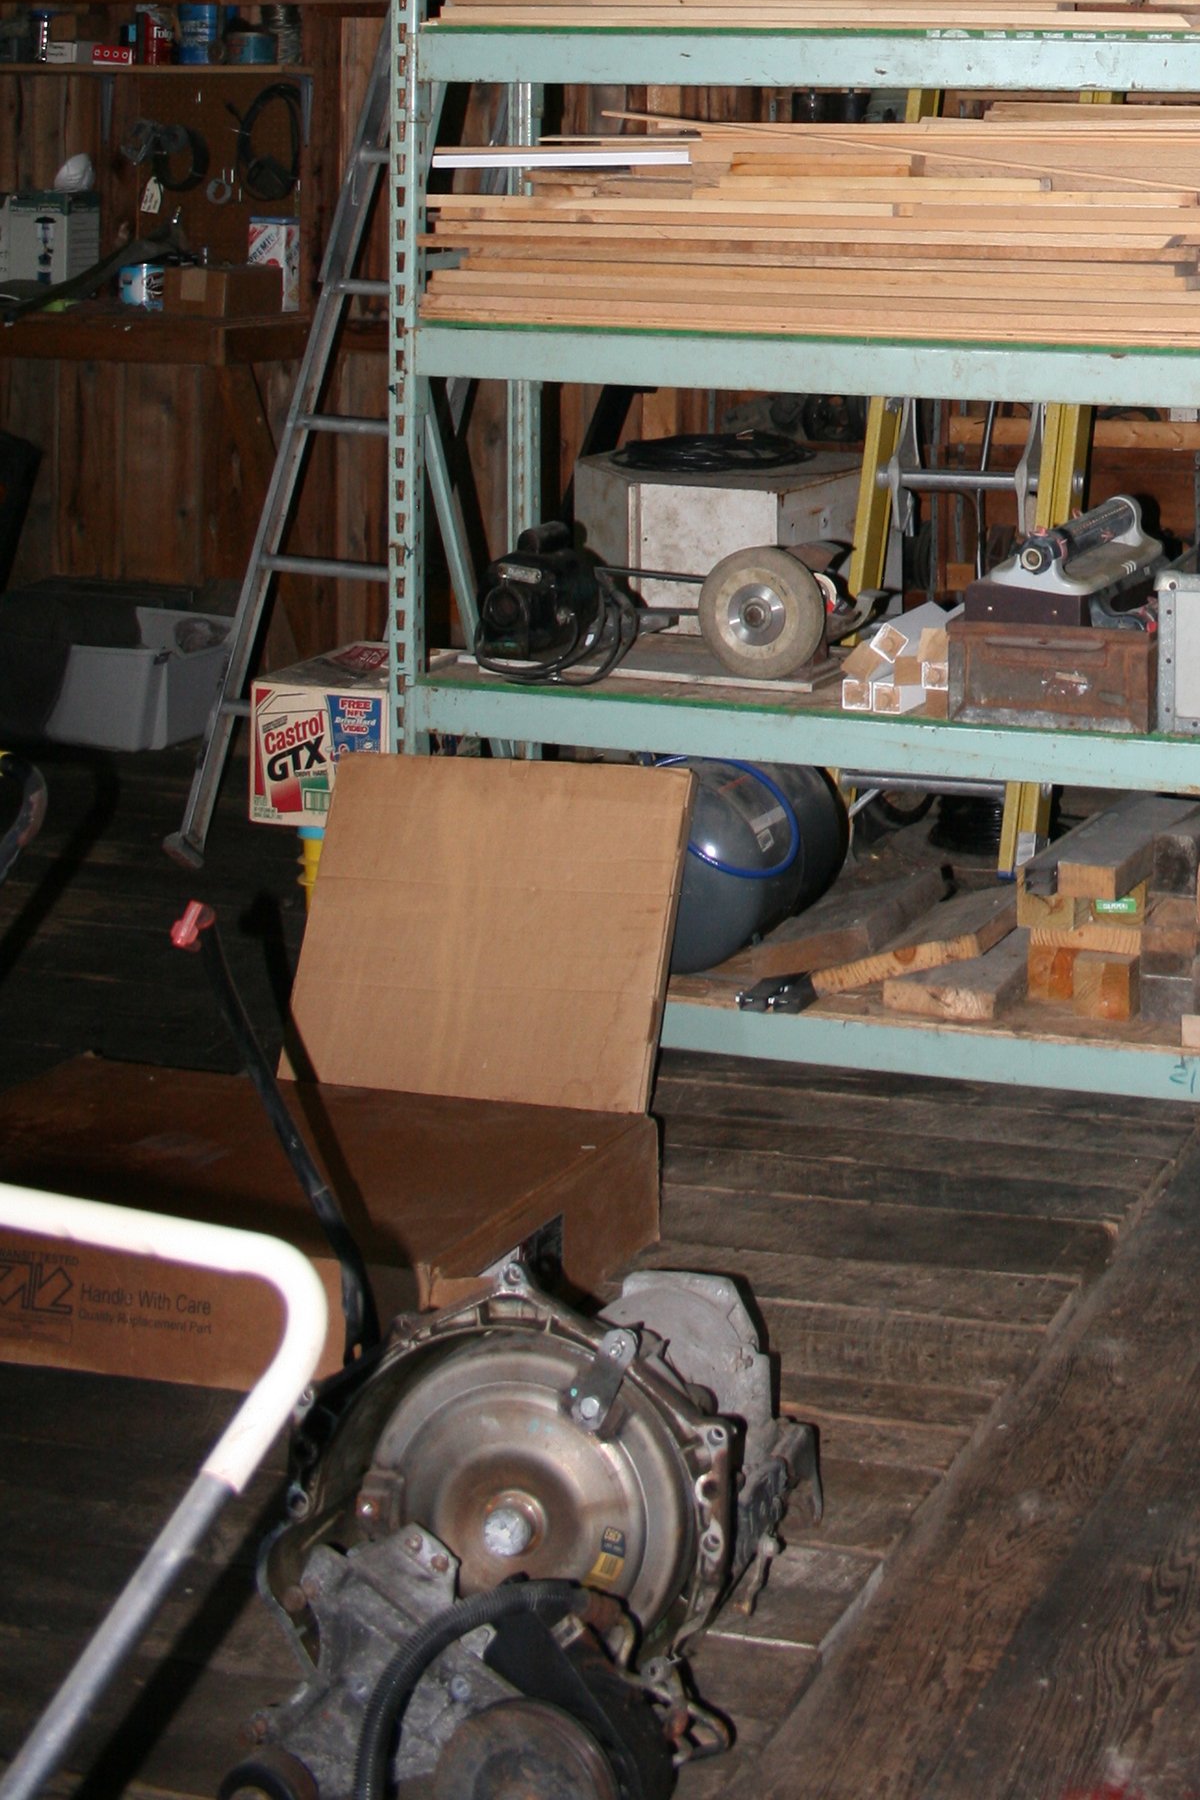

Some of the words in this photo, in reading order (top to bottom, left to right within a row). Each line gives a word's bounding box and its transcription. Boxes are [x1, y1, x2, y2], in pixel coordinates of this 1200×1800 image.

[340, 699, 371, 710] FREE
[346, 709, 365, 717] NFL
[264, 710, 325, 755] Castrol
[342, 725, 368, 733] VIDEO
[267, 735, 327, 781] GTX
[80, 1283, 133, 1307] Handle
[139, 1290, 171, 1310] With
[176, 1294, 212, 1315] Care
[78, 1308, 113, 1323] Quality
[117, 1314, 186, 1333] Replacement
[189, 1322, 212, 1334] Part
